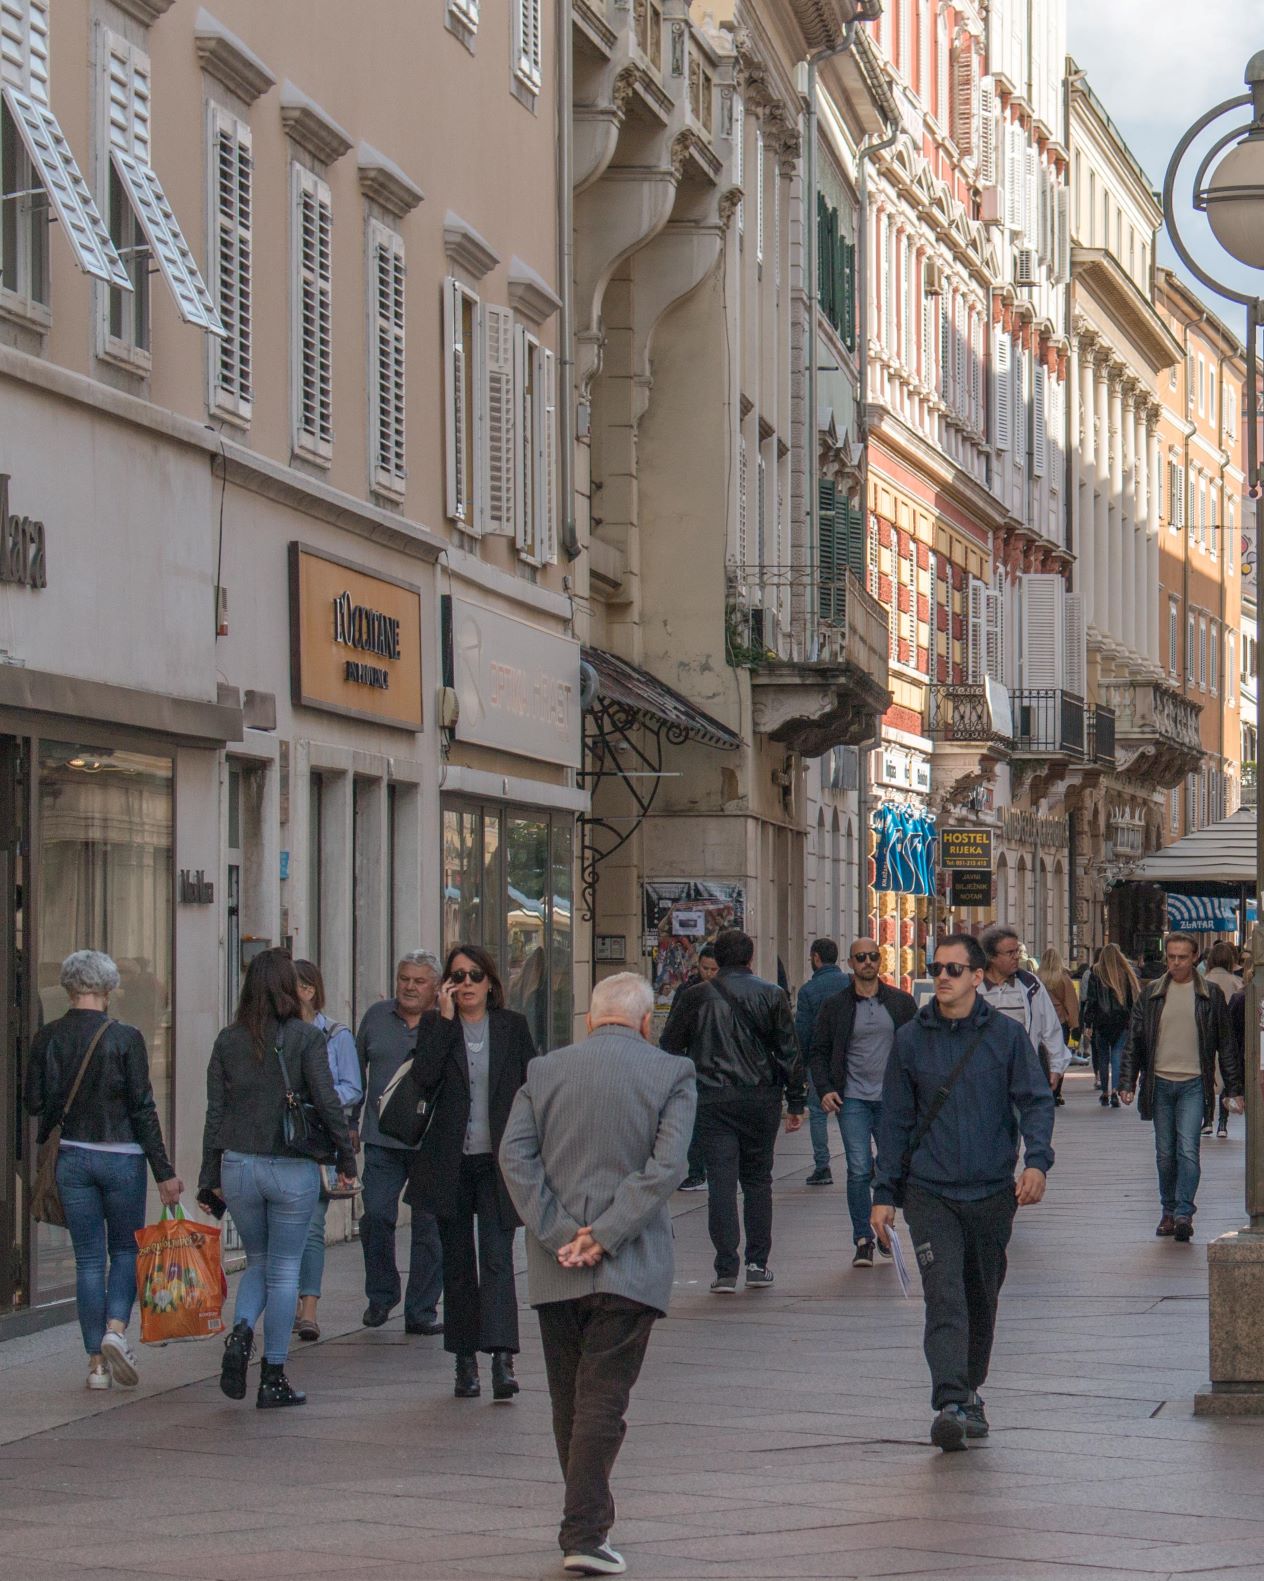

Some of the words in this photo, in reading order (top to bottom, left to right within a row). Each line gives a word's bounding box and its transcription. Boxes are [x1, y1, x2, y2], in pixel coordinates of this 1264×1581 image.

[943, 833, 990, 844] HOSTEL
[950, 845, 983, 855] RIJEKA
[1180, 920, 1215, 929] ZLATAR
